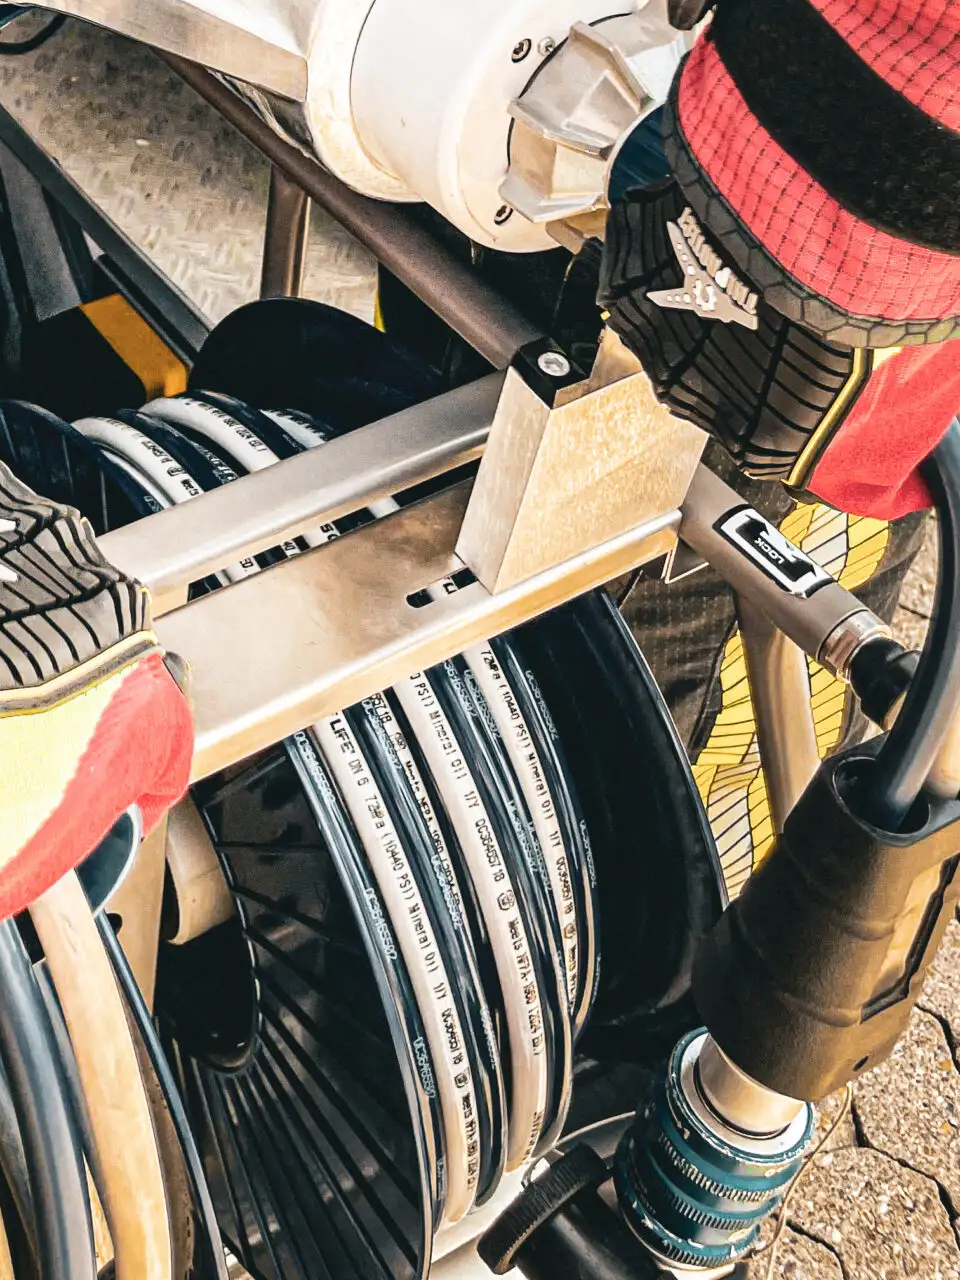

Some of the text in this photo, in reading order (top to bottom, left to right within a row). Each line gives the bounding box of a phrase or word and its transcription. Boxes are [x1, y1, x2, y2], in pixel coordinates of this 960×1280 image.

[754, 537, 785, 565] LOCK
[429, 710, 457, 756] Mineral
[357, 777, 370, 787] 6
[407, 902, 432, 950] Mineral
